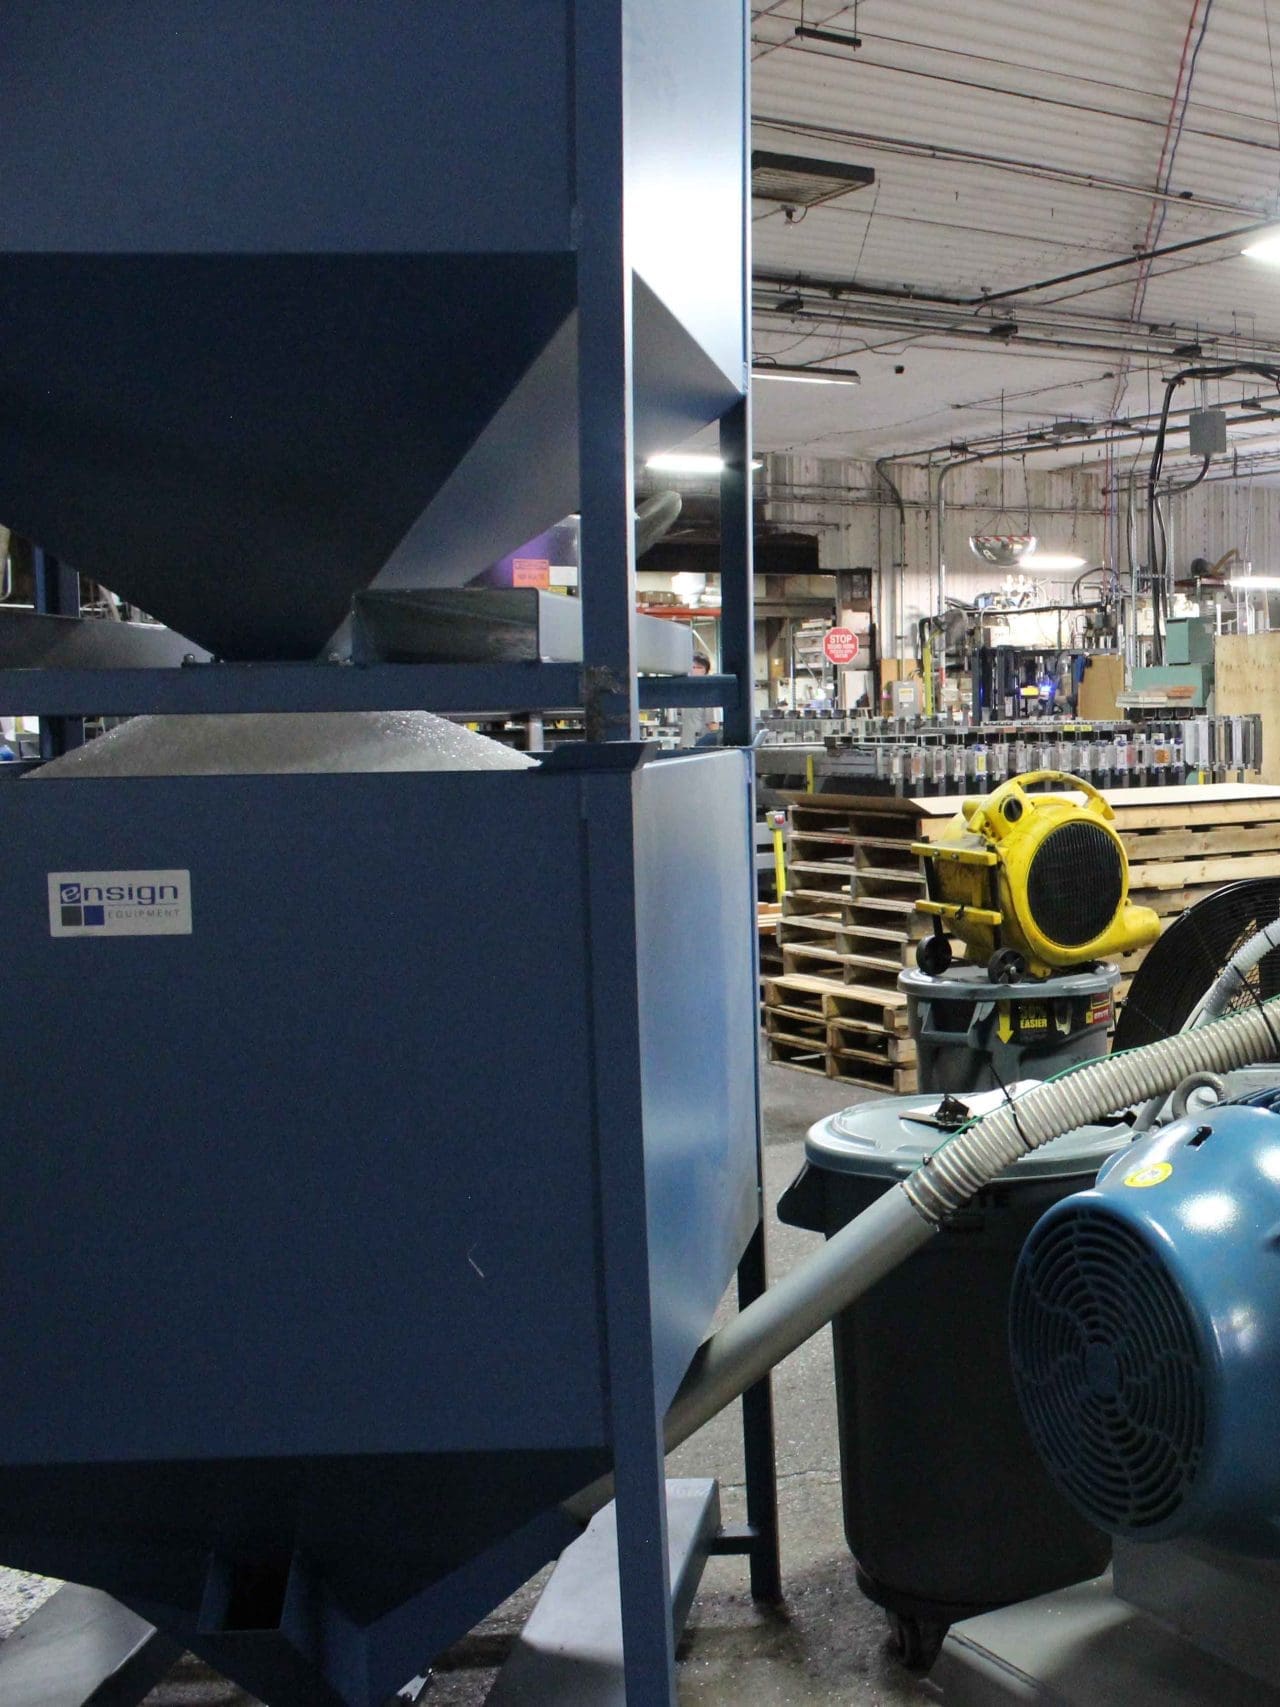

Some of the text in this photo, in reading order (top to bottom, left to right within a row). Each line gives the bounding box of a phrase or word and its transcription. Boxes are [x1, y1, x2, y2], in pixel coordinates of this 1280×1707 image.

[830, 634, 852, 644] STOP
[60, 883, 178, 905] ensign
[108, 909, 180, 919] EQUIPMENT
[1020, 1018, 1047, 1029] EASIER
